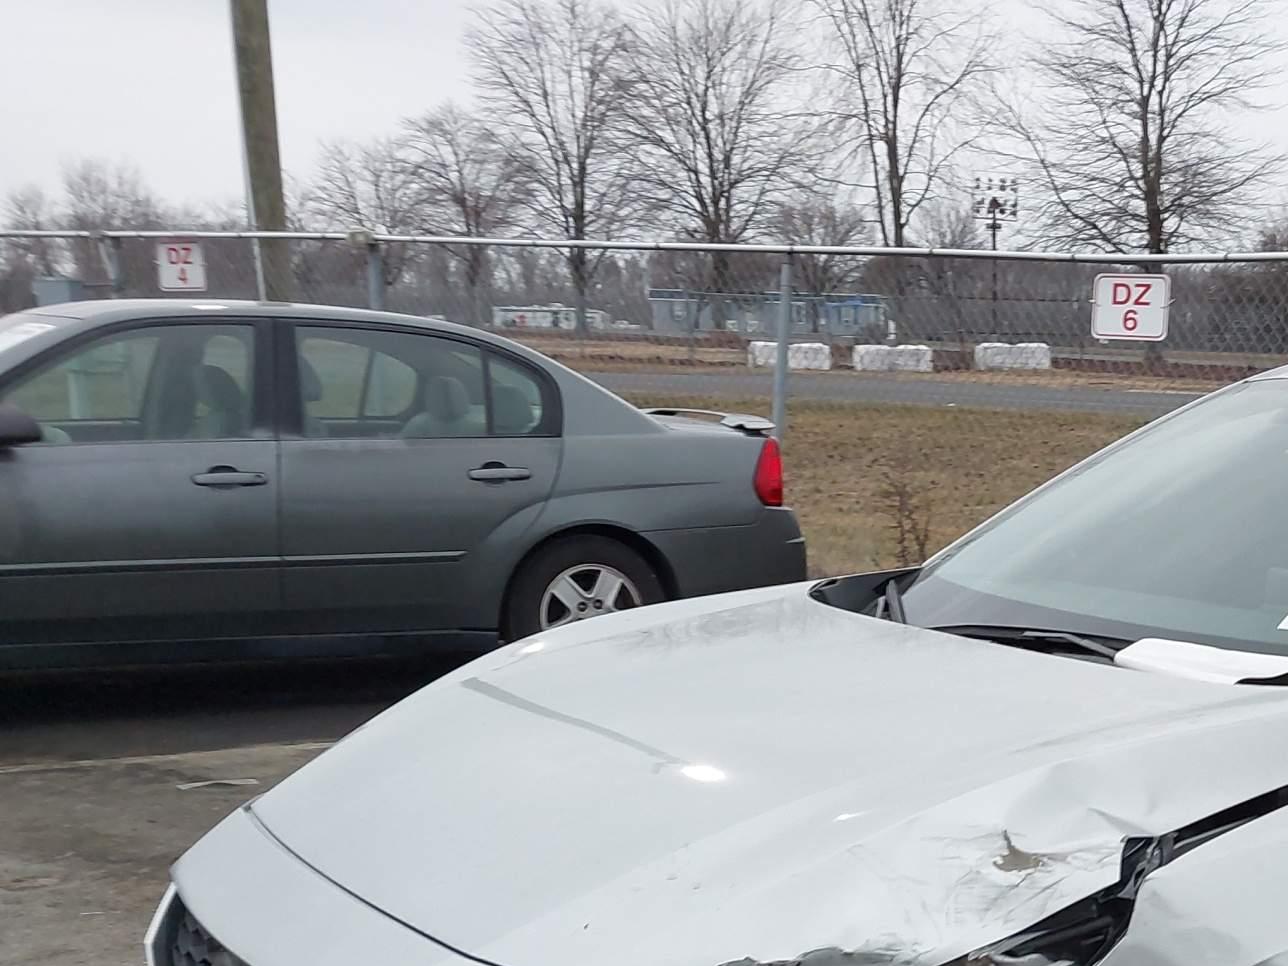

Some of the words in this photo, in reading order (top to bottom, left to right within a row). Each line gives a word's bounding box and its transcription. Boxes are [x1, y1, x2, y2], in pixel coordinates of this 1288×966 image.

[168, 247, 194, 264] DZ
[1111, 282, 1152, 306] DZ
[1123, 309, 1138, 331] 6
